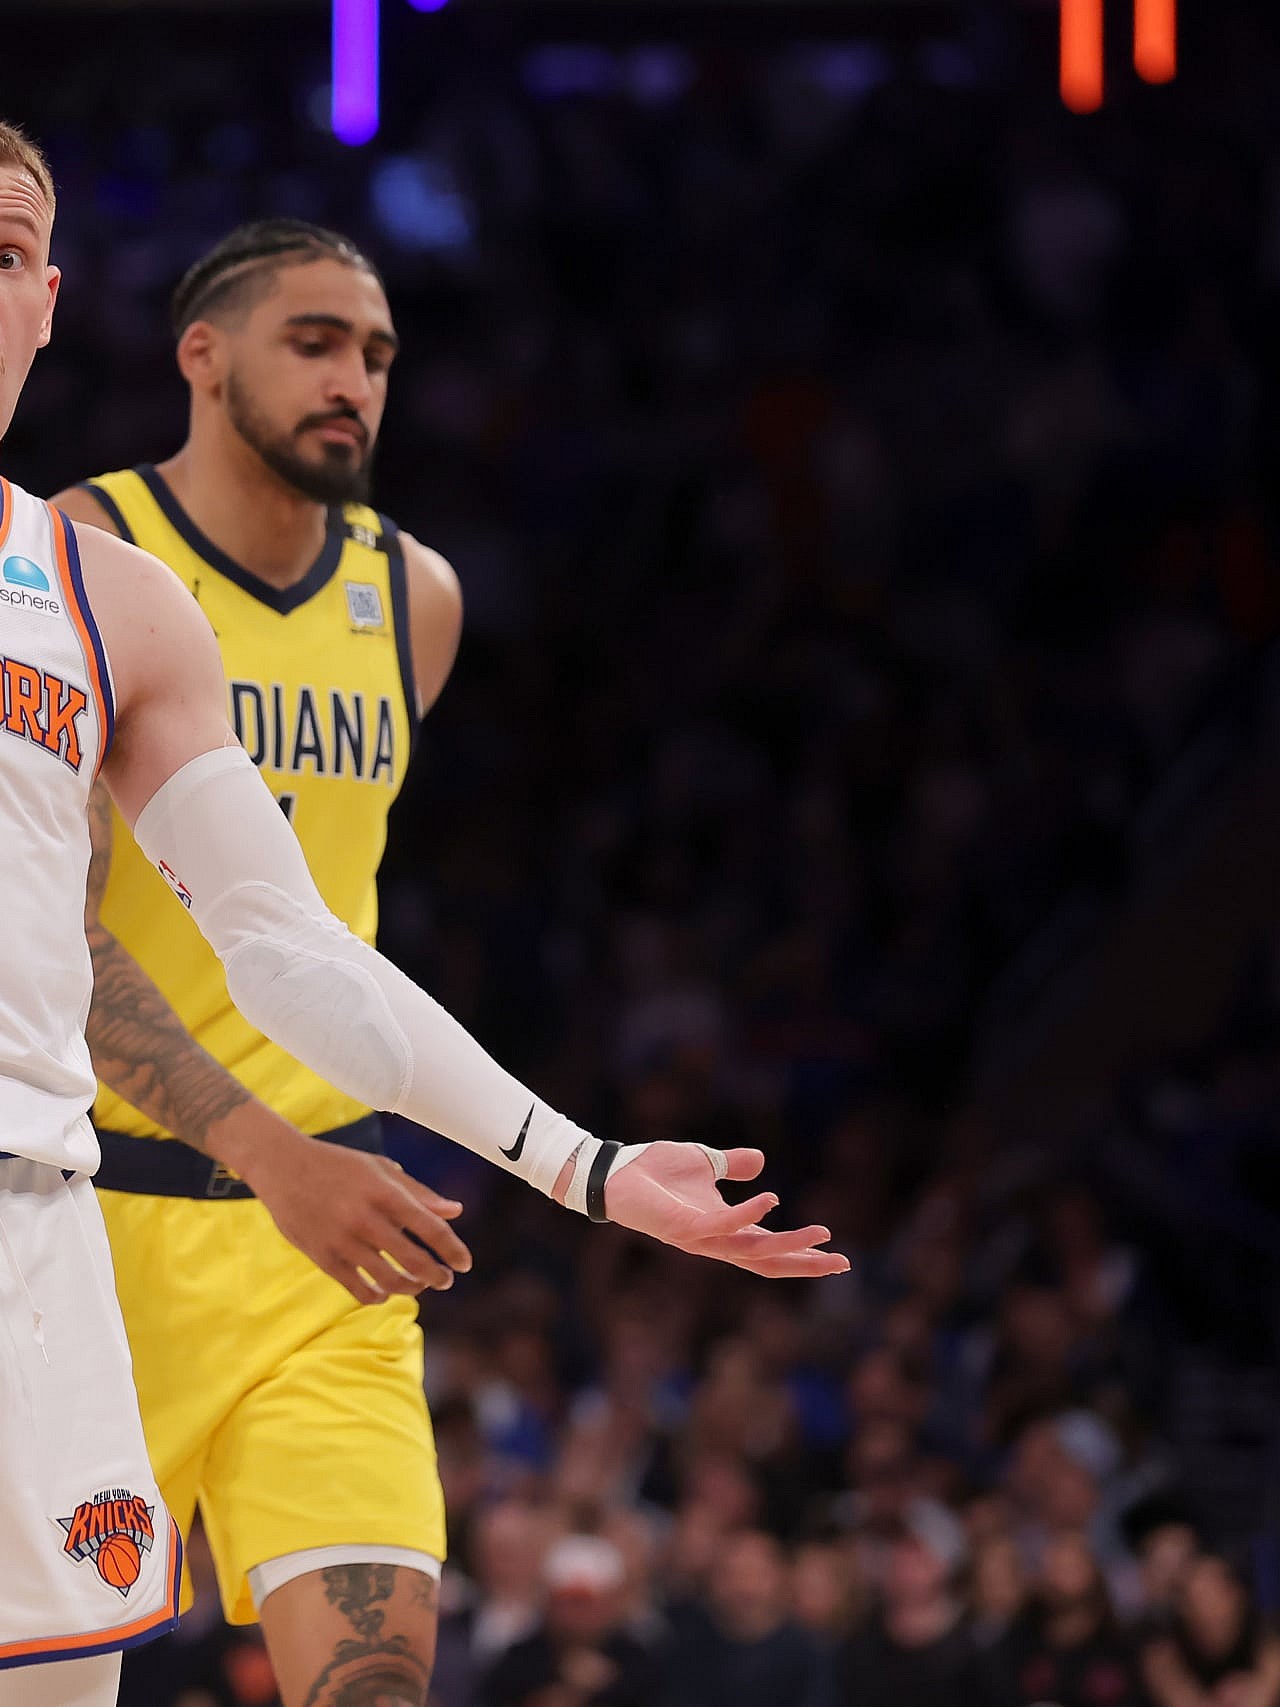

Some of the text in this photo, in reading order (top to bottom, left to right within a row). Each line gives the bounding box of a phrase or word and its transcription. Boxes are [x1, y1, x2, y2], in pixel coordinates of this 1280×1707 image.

[0, 588, 60, 614] sphere
[230, 682, 395, 784] DIANA
[93, 1488, 132, 1505] NEW YORK
[64, 1495, 155, 1557] KNICKS
